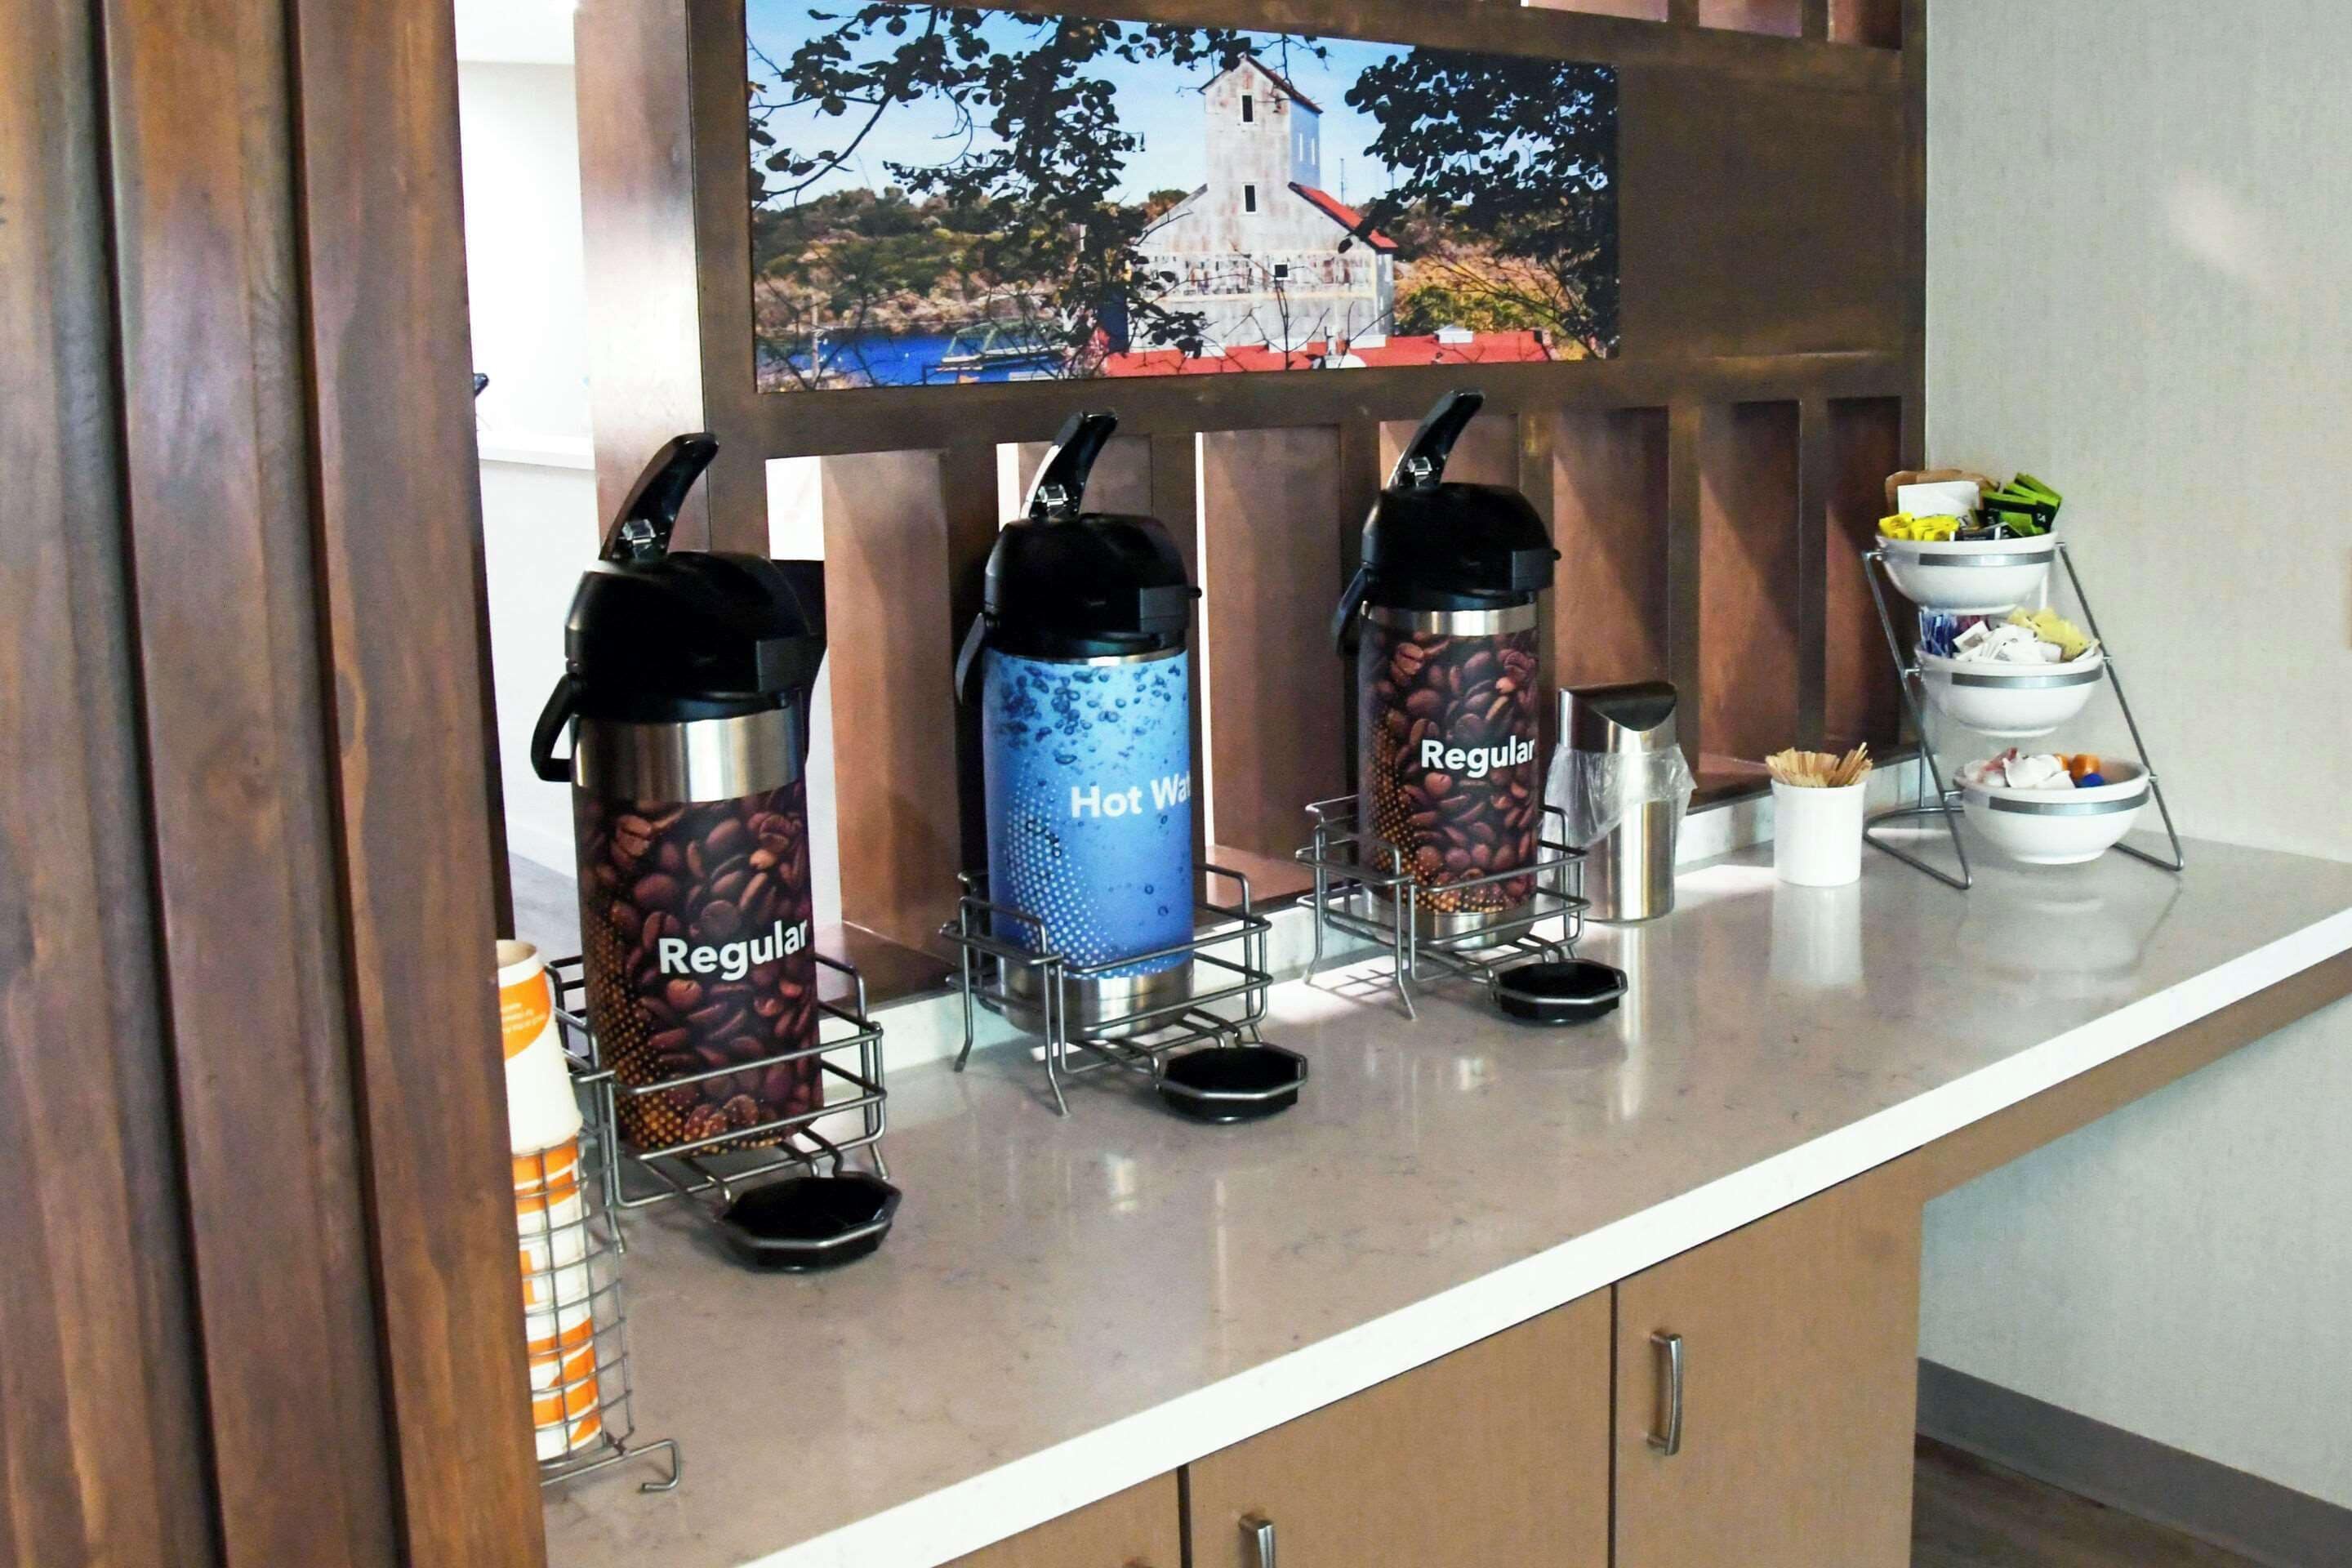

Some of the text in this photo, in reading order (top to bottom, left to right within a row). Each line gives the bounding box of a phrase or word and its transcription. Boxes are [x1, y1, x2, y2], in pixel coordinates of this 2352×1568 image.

[1421, 735, 1535, 778] Regular
[1071, 785, 1143, 817] Hot
[658, 920, 808, 981] Regular
